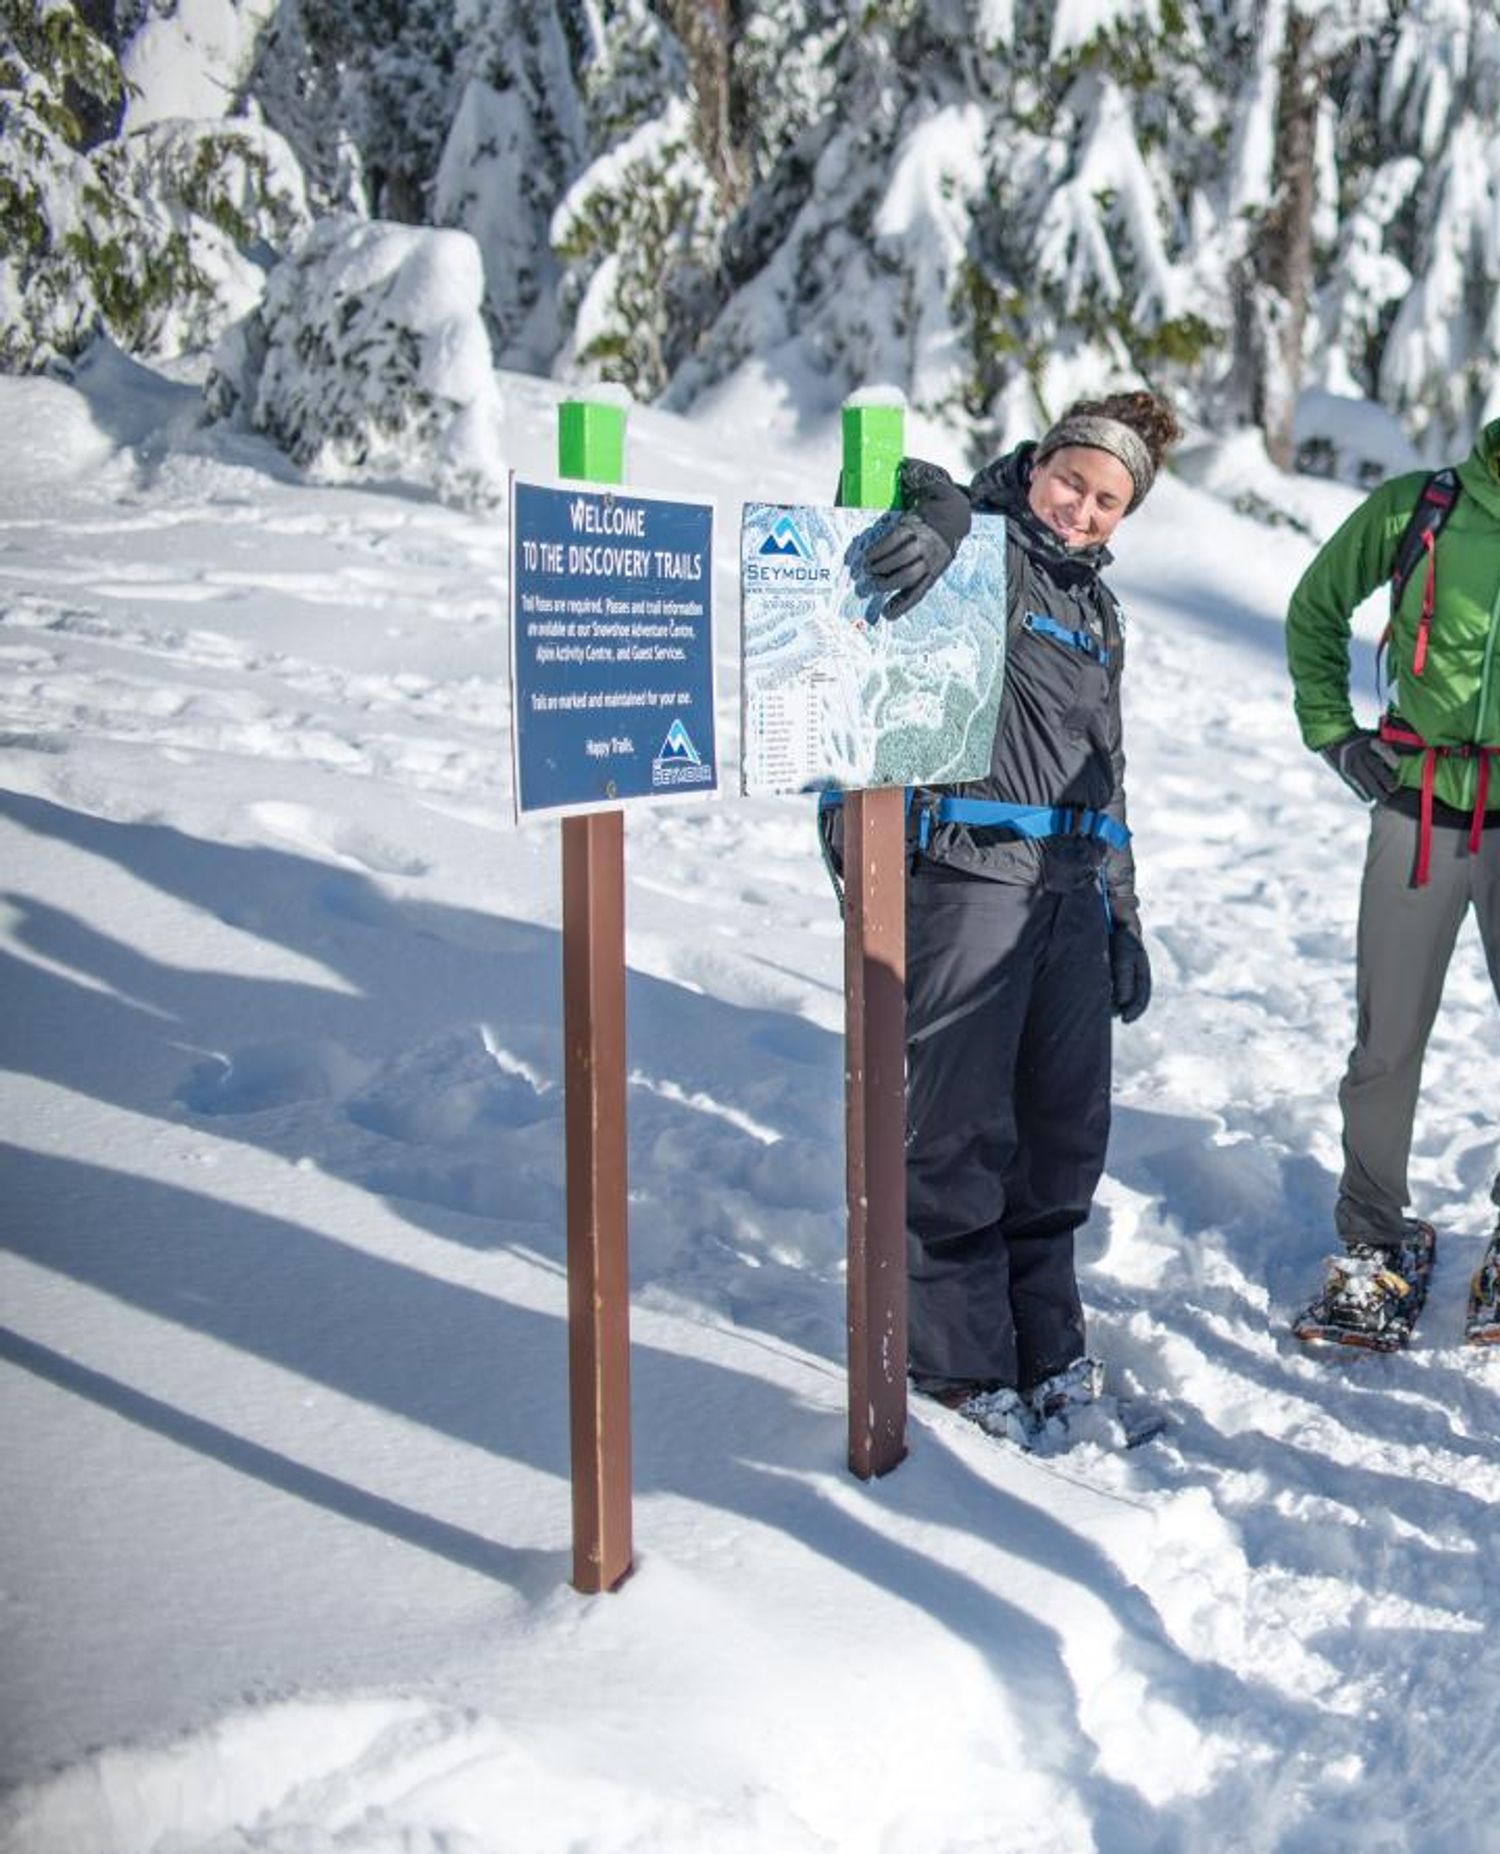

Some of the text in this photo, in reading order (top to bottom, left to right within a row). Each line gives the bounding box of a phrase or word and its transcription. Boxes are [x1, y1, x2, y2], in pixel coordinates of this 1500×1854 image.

[570, 500, 646, 536] WELCOME
[522, 541, 702, 581] TO THE DISCOVERY TRAILS
[747, 564, 831, 581] SEYMOUR
[554, 599, 566, 612] are
[567, 597, 604, 616] required.
[606, 597, 630, 614] Passes
[631, 599, 645, 614] and
[646, 599, 662, 614] trail
[663, 599, 703, 615] information
[538, 621, 566, 637] available
[567, 623, 576, 637] at
[577, 624, 592, 637] our
[592, 621, 630, 637] Snowshoe
[631, 622, 667, 638] Adventure
[556, 645, 585, 665] Activity
[617, 646, 631, 661] and
[632, 645, 654, 661] Guest
[654, 645, 686, 661] Services.
[548, 696, 558, 710] are
[558, 692, 587, 709] marked
[588, 692, 603, 707] and
[604, 690, 646, 707] maintained
[647, 689, 658, 705] for
[659, 692, 676, 708] your
[585, 739, 609, 759] Happy
[652, 765, 712, 787] SEYMOUR
